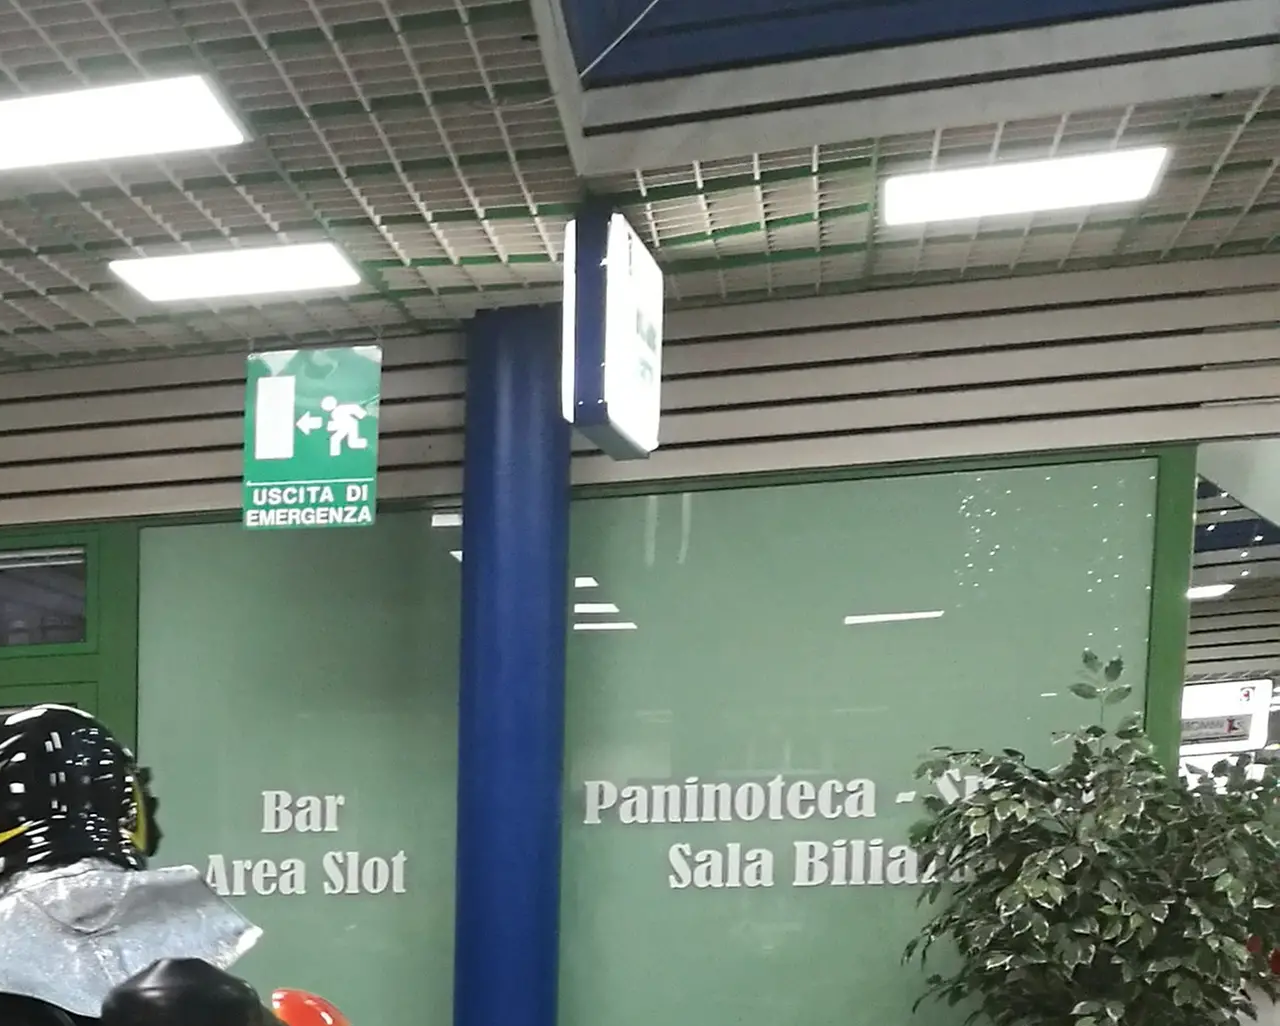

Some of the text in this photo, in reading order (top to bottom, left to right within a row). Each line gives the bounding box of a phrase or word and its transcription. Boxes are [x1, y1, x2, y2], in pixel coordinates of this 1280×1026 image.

[246, 506, 372, 526] EMERGENZA
[253, 484, 369, 505] USCITA DI
[260, 789, 346, 834] Bar
[582, 773, 877, 825] Paninoteca
[206, 850, 408, 896] Area Slot
[668, 842, 775, 889] Sala
